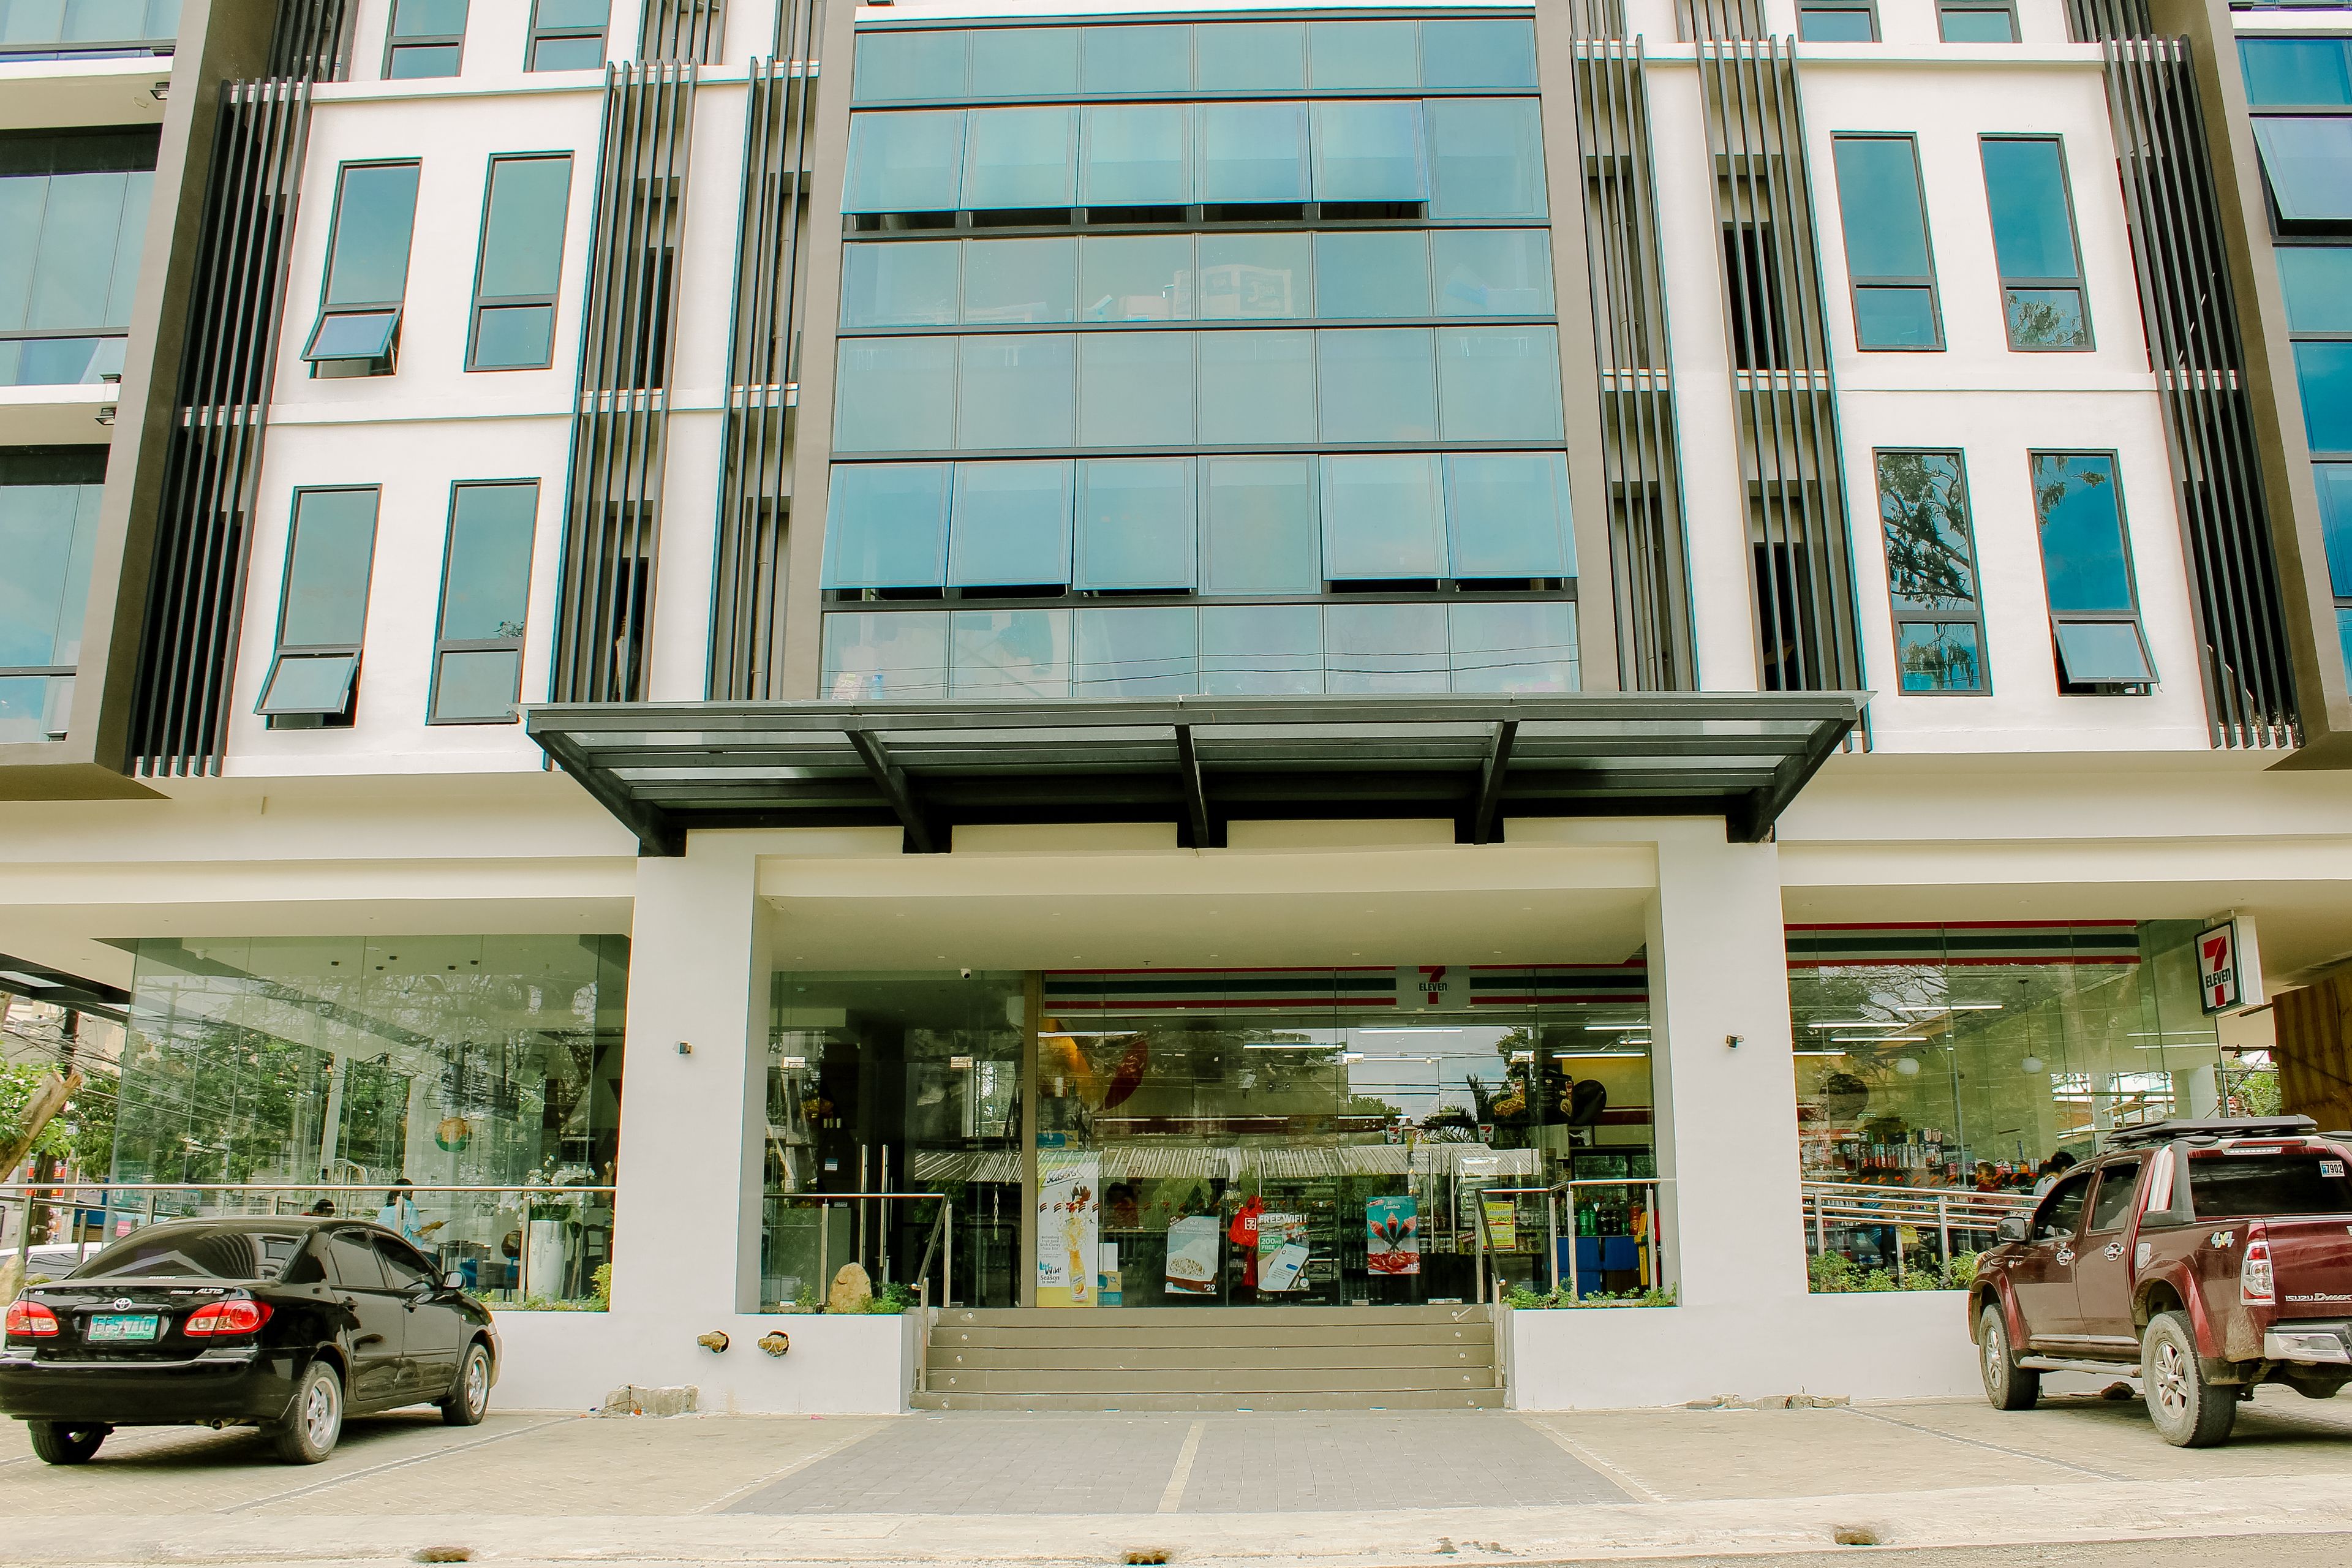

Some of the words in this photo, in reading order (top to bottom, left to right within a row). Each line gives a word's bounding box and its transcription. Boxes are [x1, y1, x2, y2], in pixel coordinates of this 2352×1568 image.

[2203, 935, 2228, 1008] 7
[1419, 965, 1447, 1005] 7
[1479, 1126, 1492, 1142] 7
[2326, 1164, 2343, 1174] 7902
[1259, 1215, 1281, 1223] FREE
